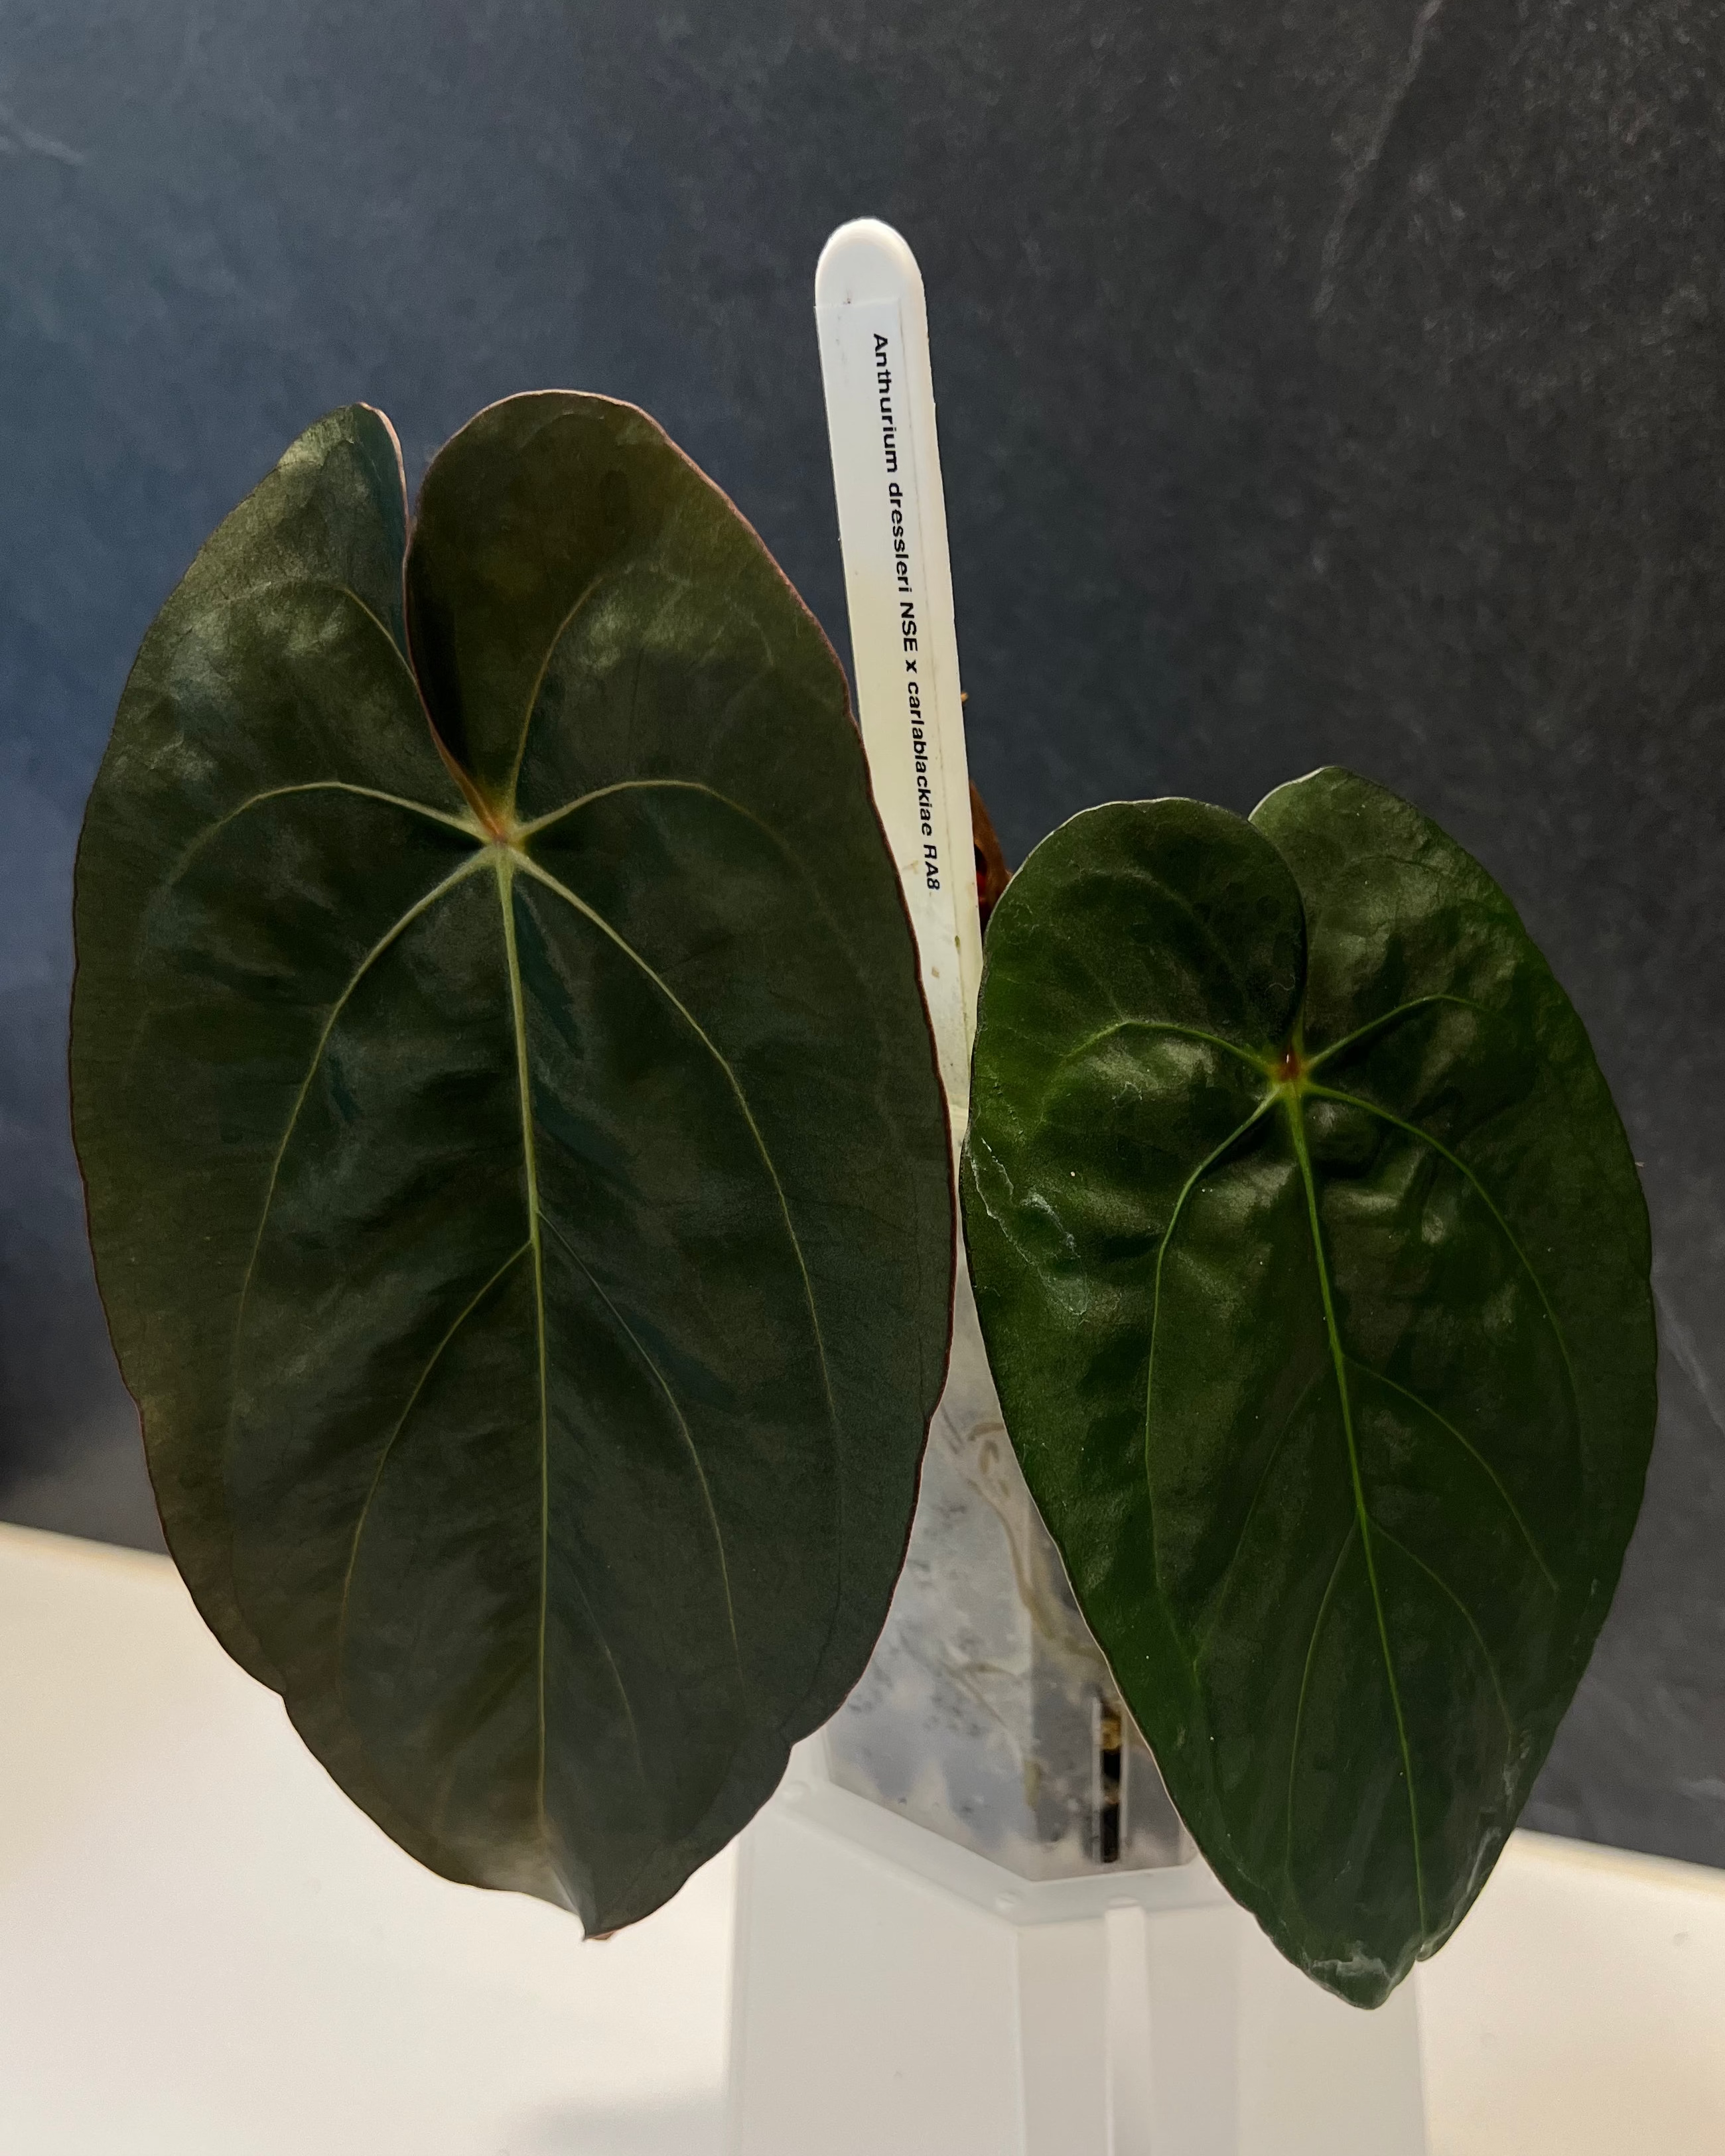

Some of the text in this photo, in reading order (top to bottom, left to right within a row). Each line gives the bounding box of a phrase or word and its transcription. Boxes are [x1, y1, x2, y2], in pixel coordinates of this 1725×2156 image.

[872, 332, 941, 891] Anthurium dressleri NSE x carlablackiae RA8
